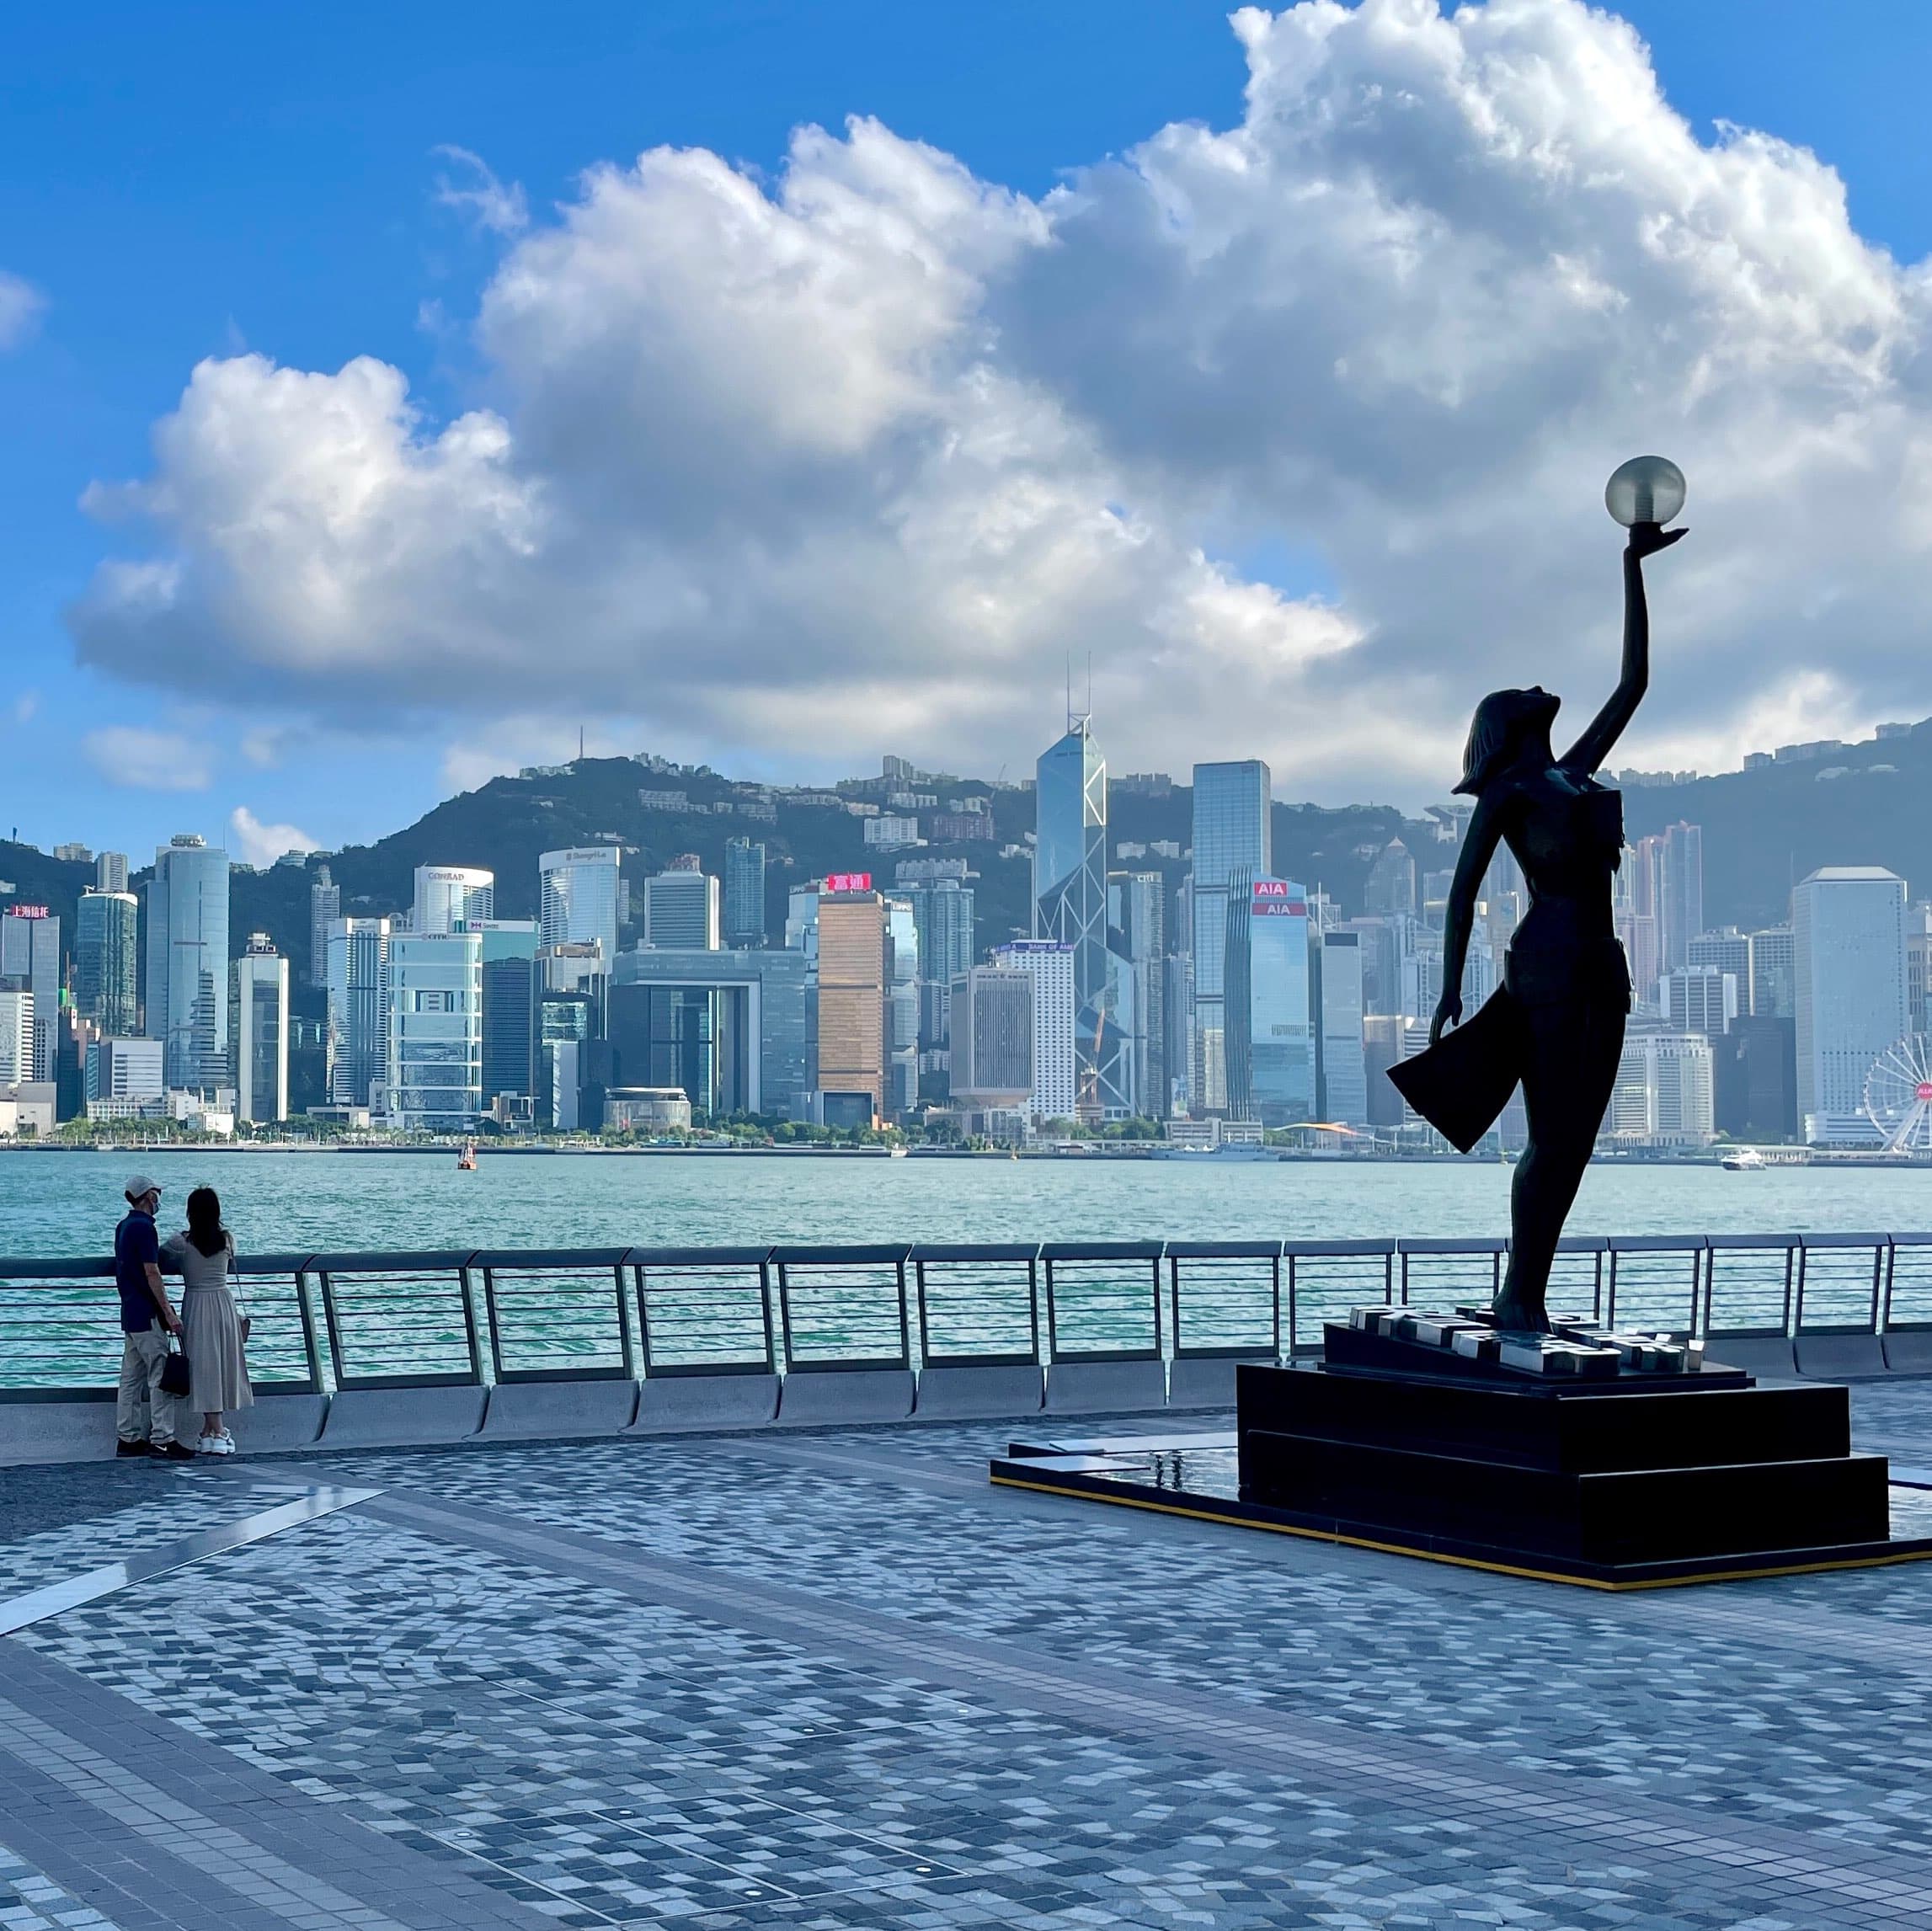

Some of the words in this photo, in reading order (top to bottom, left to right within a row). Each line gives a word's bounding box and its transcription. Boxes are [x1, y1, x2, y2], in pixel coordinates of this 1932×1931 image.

[428, 872, 464, 881] CONRAD
[1258, 883, 1284, 894] AIA
[1268, 904, 1290, 915] AIA
